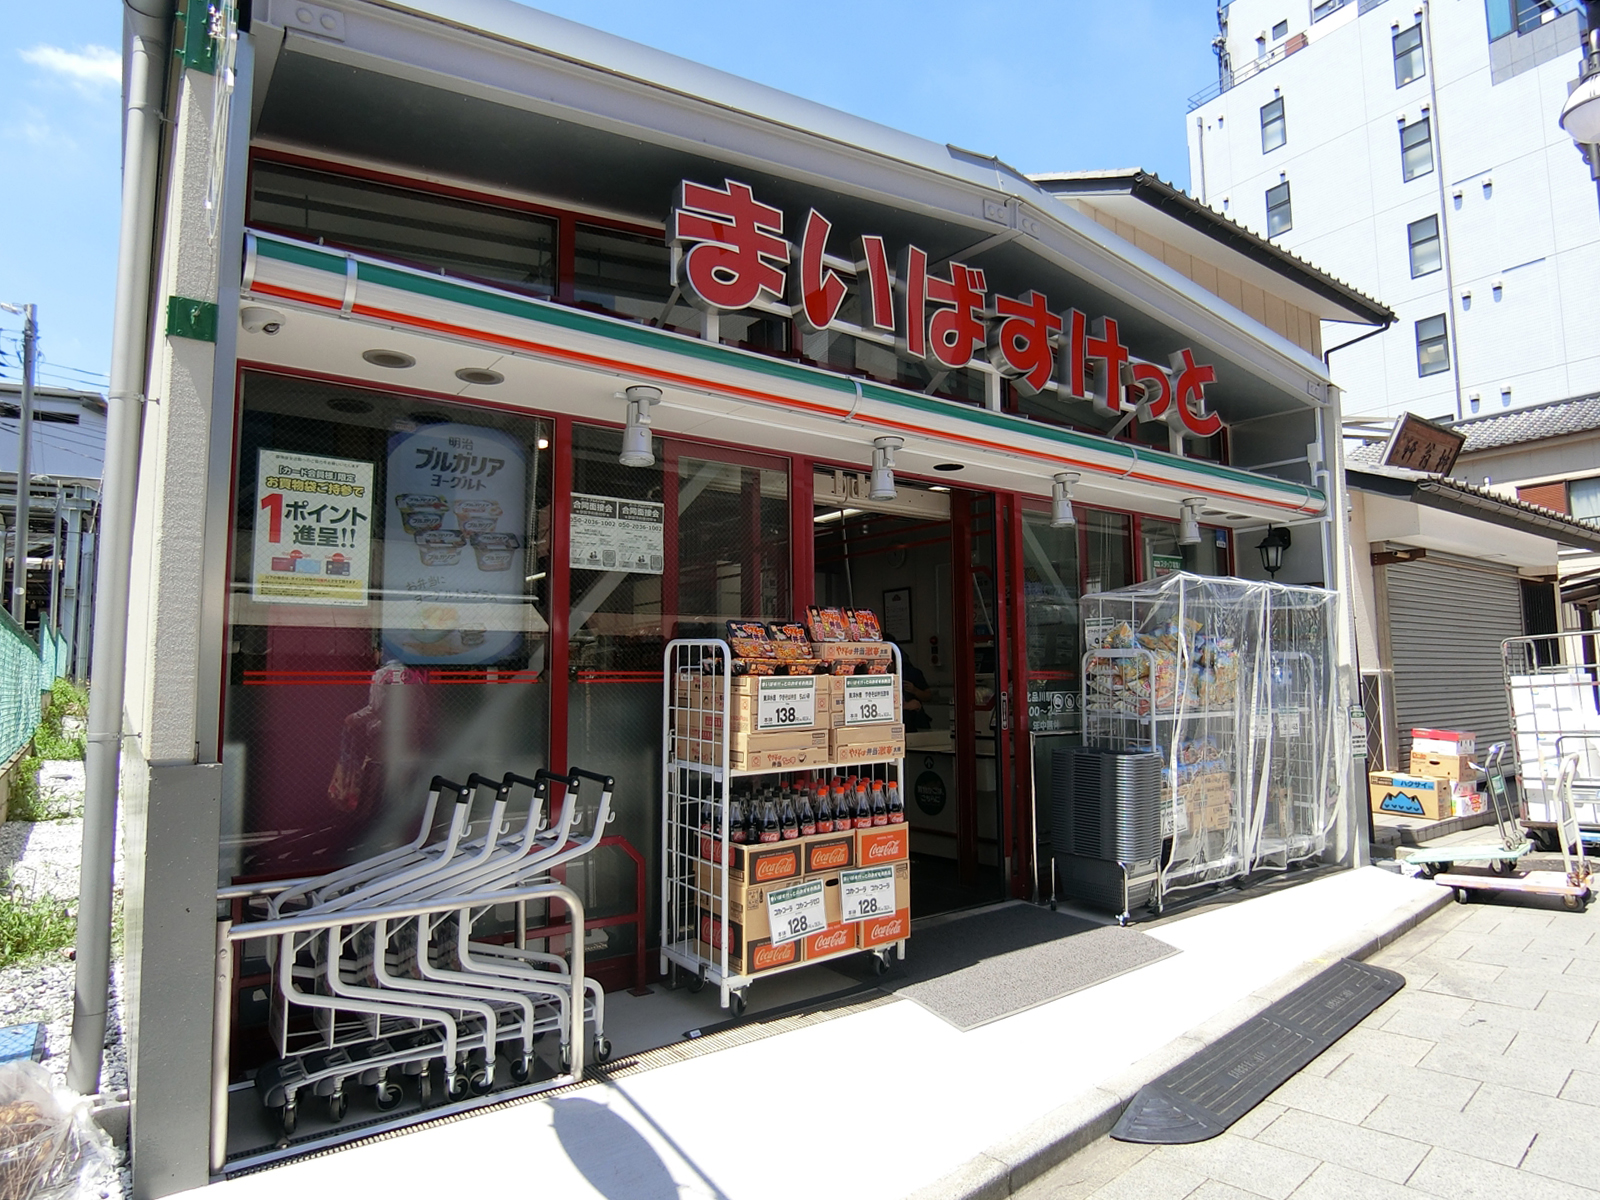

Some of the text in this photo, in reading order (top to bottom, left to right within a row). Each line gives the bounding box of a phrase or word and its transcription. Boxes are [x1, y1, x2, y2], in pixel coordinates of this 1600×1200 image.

[672, 177, 1223, 438] まいばすけっと
[448, 436, 474, 451] 明治
[415, 446, 506, 478] ブルガリア
[278, 464, 357, 483] 「カード会員様」限定
[430, 473, 487, 492] ヨーグルト
[265, 476, 366, 498] お買物袋ご持参で
[572, 500, 614, 514] 合同面接会
[621, 505, 661, 518] 合同面接会
[261, 492, 368, 543] 1 ポイント
[618, 522, 662, 532] 050-2036-1002
[405, 575, 446, 591] お弁当に
[775, 706, 796, 723] 138
[859, 703, 878, 719] 138
[1400, 780, 1428, 789] ハクサイ
[812, 847, 847, 867] Coca-Cola
[868, 839, 902, 859] Coca-Cola
[757, 855, 794, 877] Coca-Cola
[858, 897, 878, 914] 128
[787, 915, 808, 934] 128
[870, 918, 903, 940] Coca-Cola
[814, 928, 849, 951] Coca-Cola
